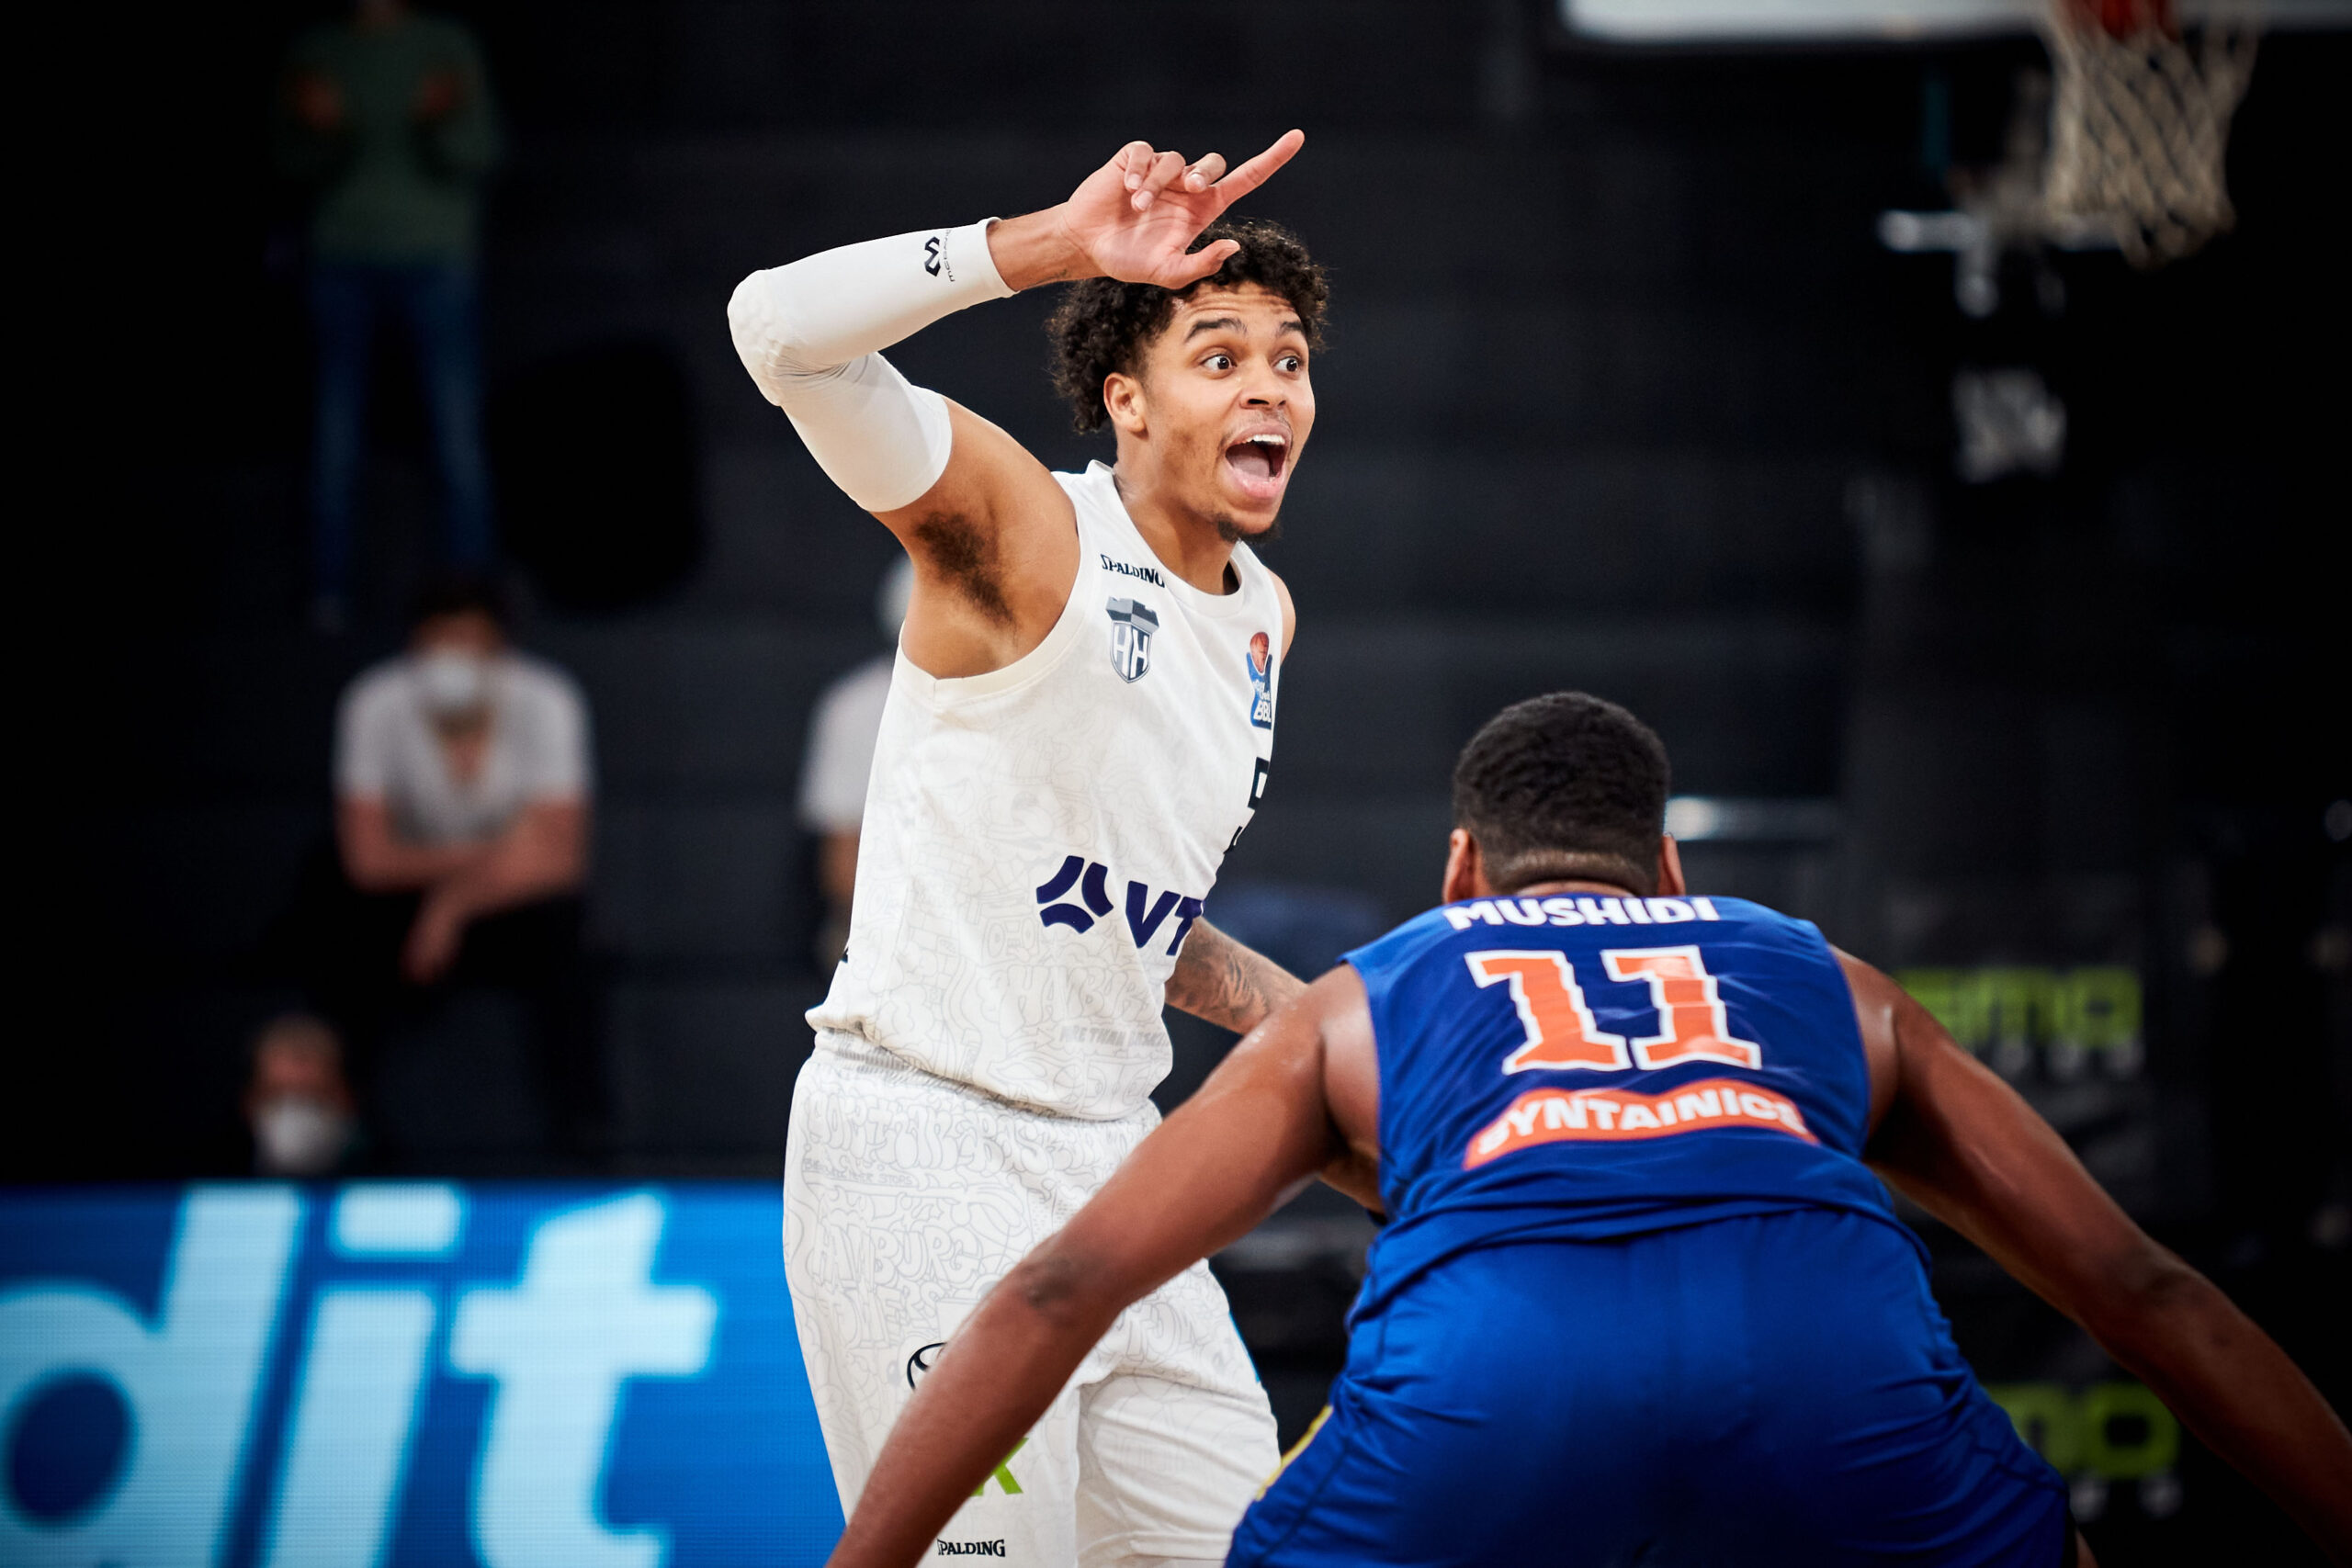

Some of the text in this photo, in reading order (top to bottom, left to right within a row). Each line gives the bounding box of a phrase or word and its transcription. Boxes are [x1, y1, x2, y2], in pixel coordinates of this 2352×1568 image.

[1253, 699, 1272, 723] BBL
[1125, 879, 1205, 957] VT
[1442, 896, 1721, 931] MUSHIDI
[1464, 944, 1762, 1077] 11
